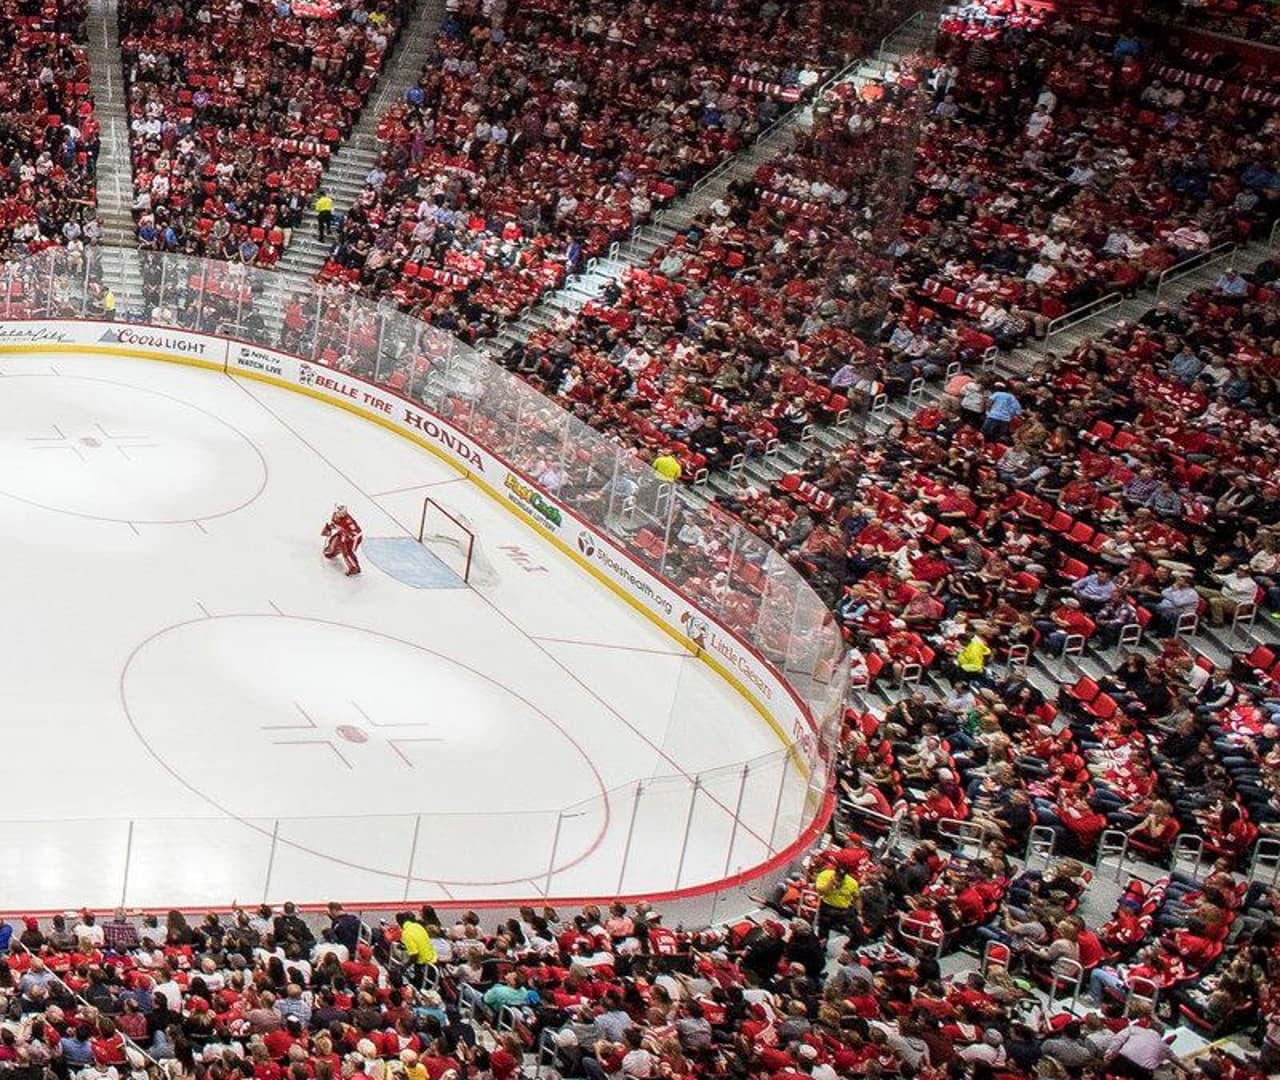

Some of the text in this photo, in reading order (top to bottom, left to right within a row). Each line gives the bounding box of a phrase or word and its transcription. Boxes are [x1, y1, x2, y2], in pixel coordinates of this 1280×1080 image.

[117, 328, 207, 354] Coors LIGHT
[315, 375, 393, 414] BELLE TIRE
[403, 408, 486, 474] HONDA
